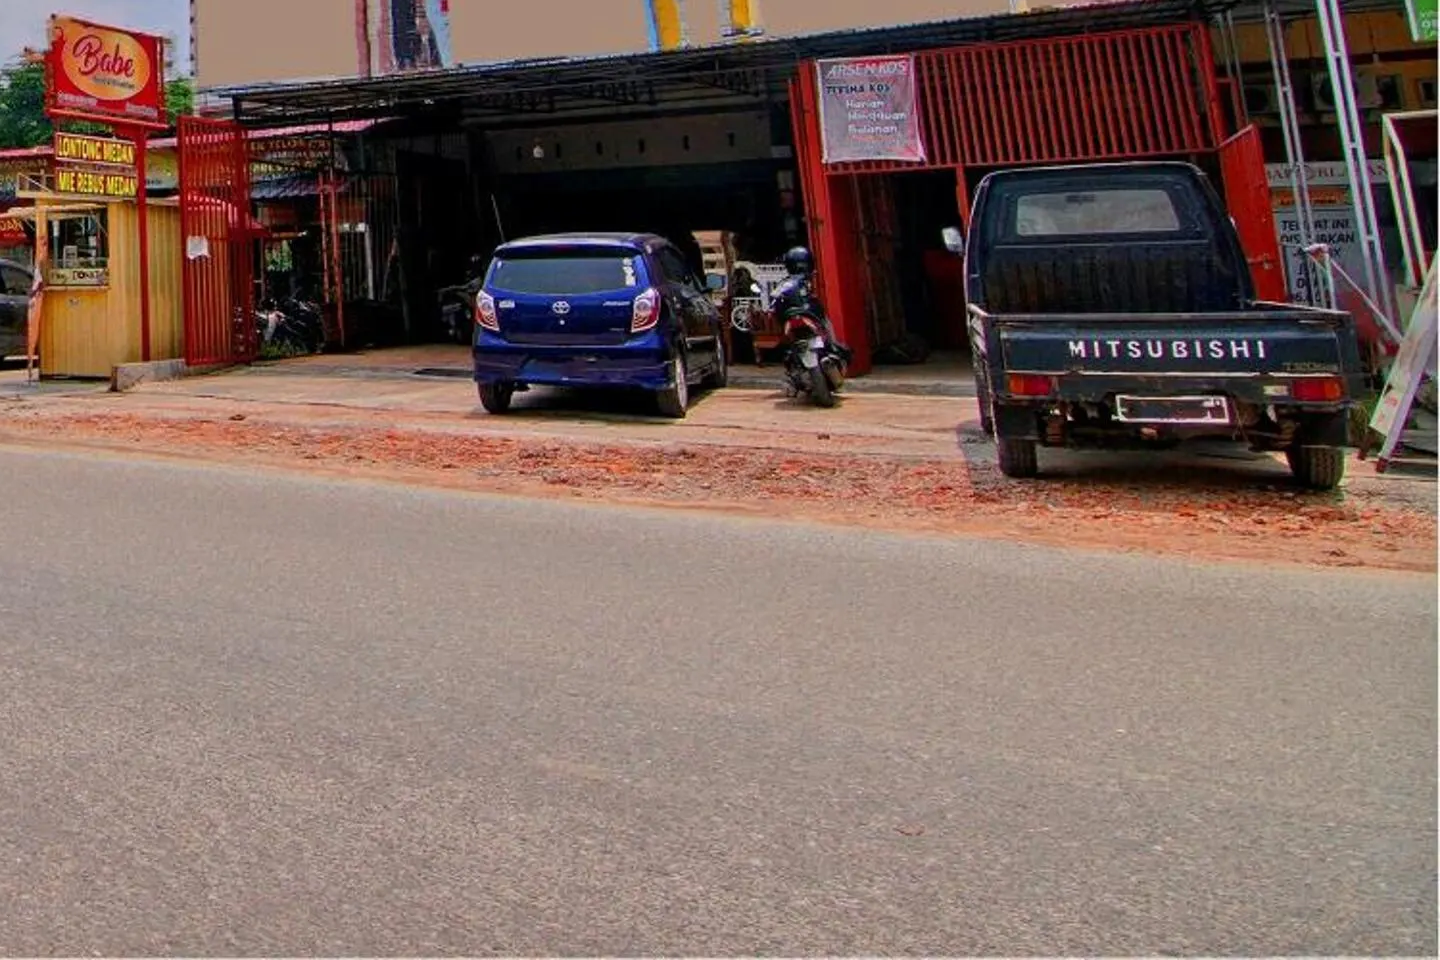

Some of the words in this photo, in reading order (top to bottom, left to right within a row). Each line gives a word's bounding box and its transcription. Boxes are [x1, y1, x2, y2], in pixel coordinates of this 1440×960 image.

[73, 34, 135, 78] Babe
[58, 136, 102, 160] LONTONG
[103, 141, 135, 164] MEDAN
[58, 171, 76, 192] MIE
[77, 172, 105, 194] REBUS
[106, 175, 136, 197] MEDAN
[1068, 340, 1266, 359] MITSUBISHI
